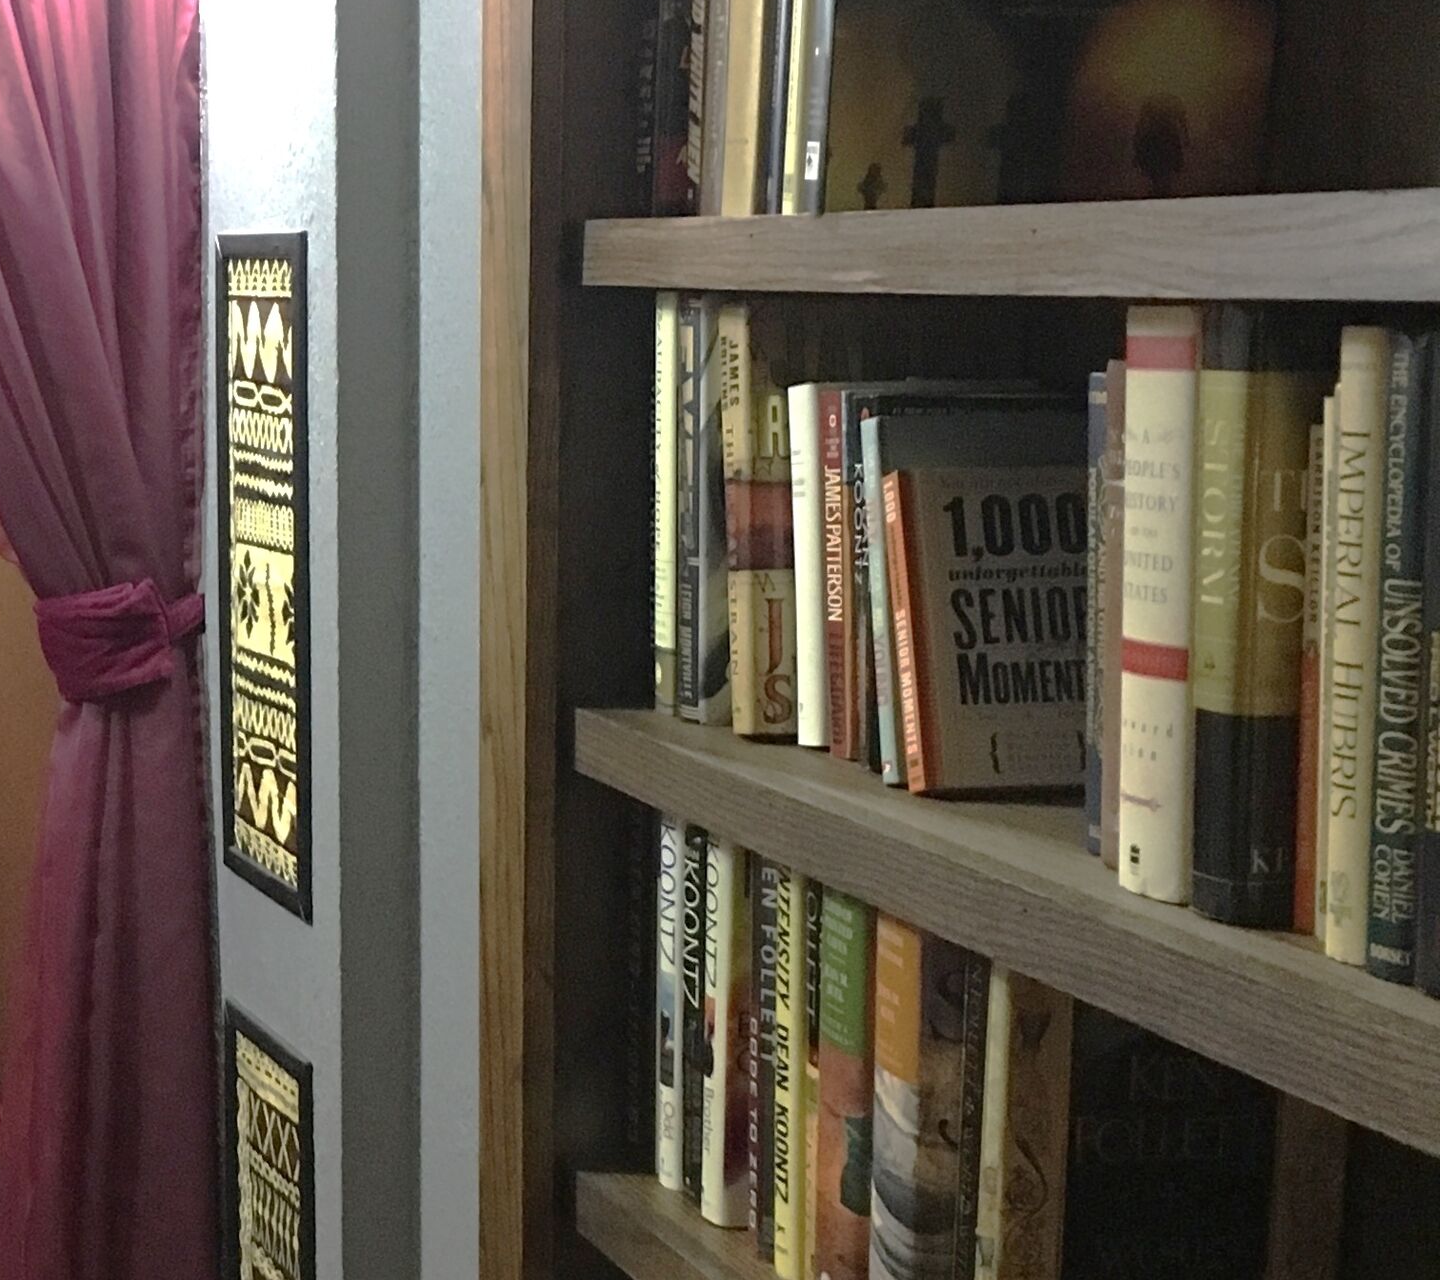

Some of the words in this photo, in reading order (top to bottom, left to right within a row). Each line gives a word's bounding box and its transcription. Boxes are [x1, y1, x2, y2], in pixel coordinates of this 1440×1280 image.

[688, 33, 704, 114] WHITE
[686, 124, 701, 185] MEN
[728, 340, 740, 407] JAMES
[1391, 352, 1409, 388] THE
[823, 466, 841, 526] JAMES
[1311, 436, 1323, 534] GARRISON
[1385, 393, 1408, 538] ENCYCLOPEDIA
[853, 463, 866, 584] KOONTZ
[942, 492, 1088, 562] 1,000
[1200, 419, 1229, 606] STORM
[1334, 431, 1371, 632] IMPERIAL
[825, 526, 843, 622] PATTERSON
[1384, 543, 1402, 571] OF
[679, 624, 693, 699] MONTVILLE
[895, 609, 910, 673] SENIOR
[956, 652, 1087, 706] MOMENT
[1380, 577, 1423, 724] UNSOLVED
[901, 673, 919, 756] MOMENTS
[1331, 661, 1364, 819] HUBRIS
[1374, 730, 1418, 835] CRIMES
[660, 822, 677, 966] KOONTZ
[705, 839, 720, 989] KOONTZ
[761, 867, 778, 909] EN
[1373, 843, 1391, 921] COHEN
[1391, 848, 1415, 924] DANIEL
[683, 854, 701, 1009] KOONTZ
[760, 924, 778, 1063] FOLLETT
[749, 1017, 759, 1100] CODE
[775, 1024, 791, 1091] DEAN
[703, 1087, 715, 1158] Brother
[748, 1106, 759, 1143] TO
[774, 1104, 790, 1205] KOONTZ
[747, 1150, 758, 1230] ZERO
